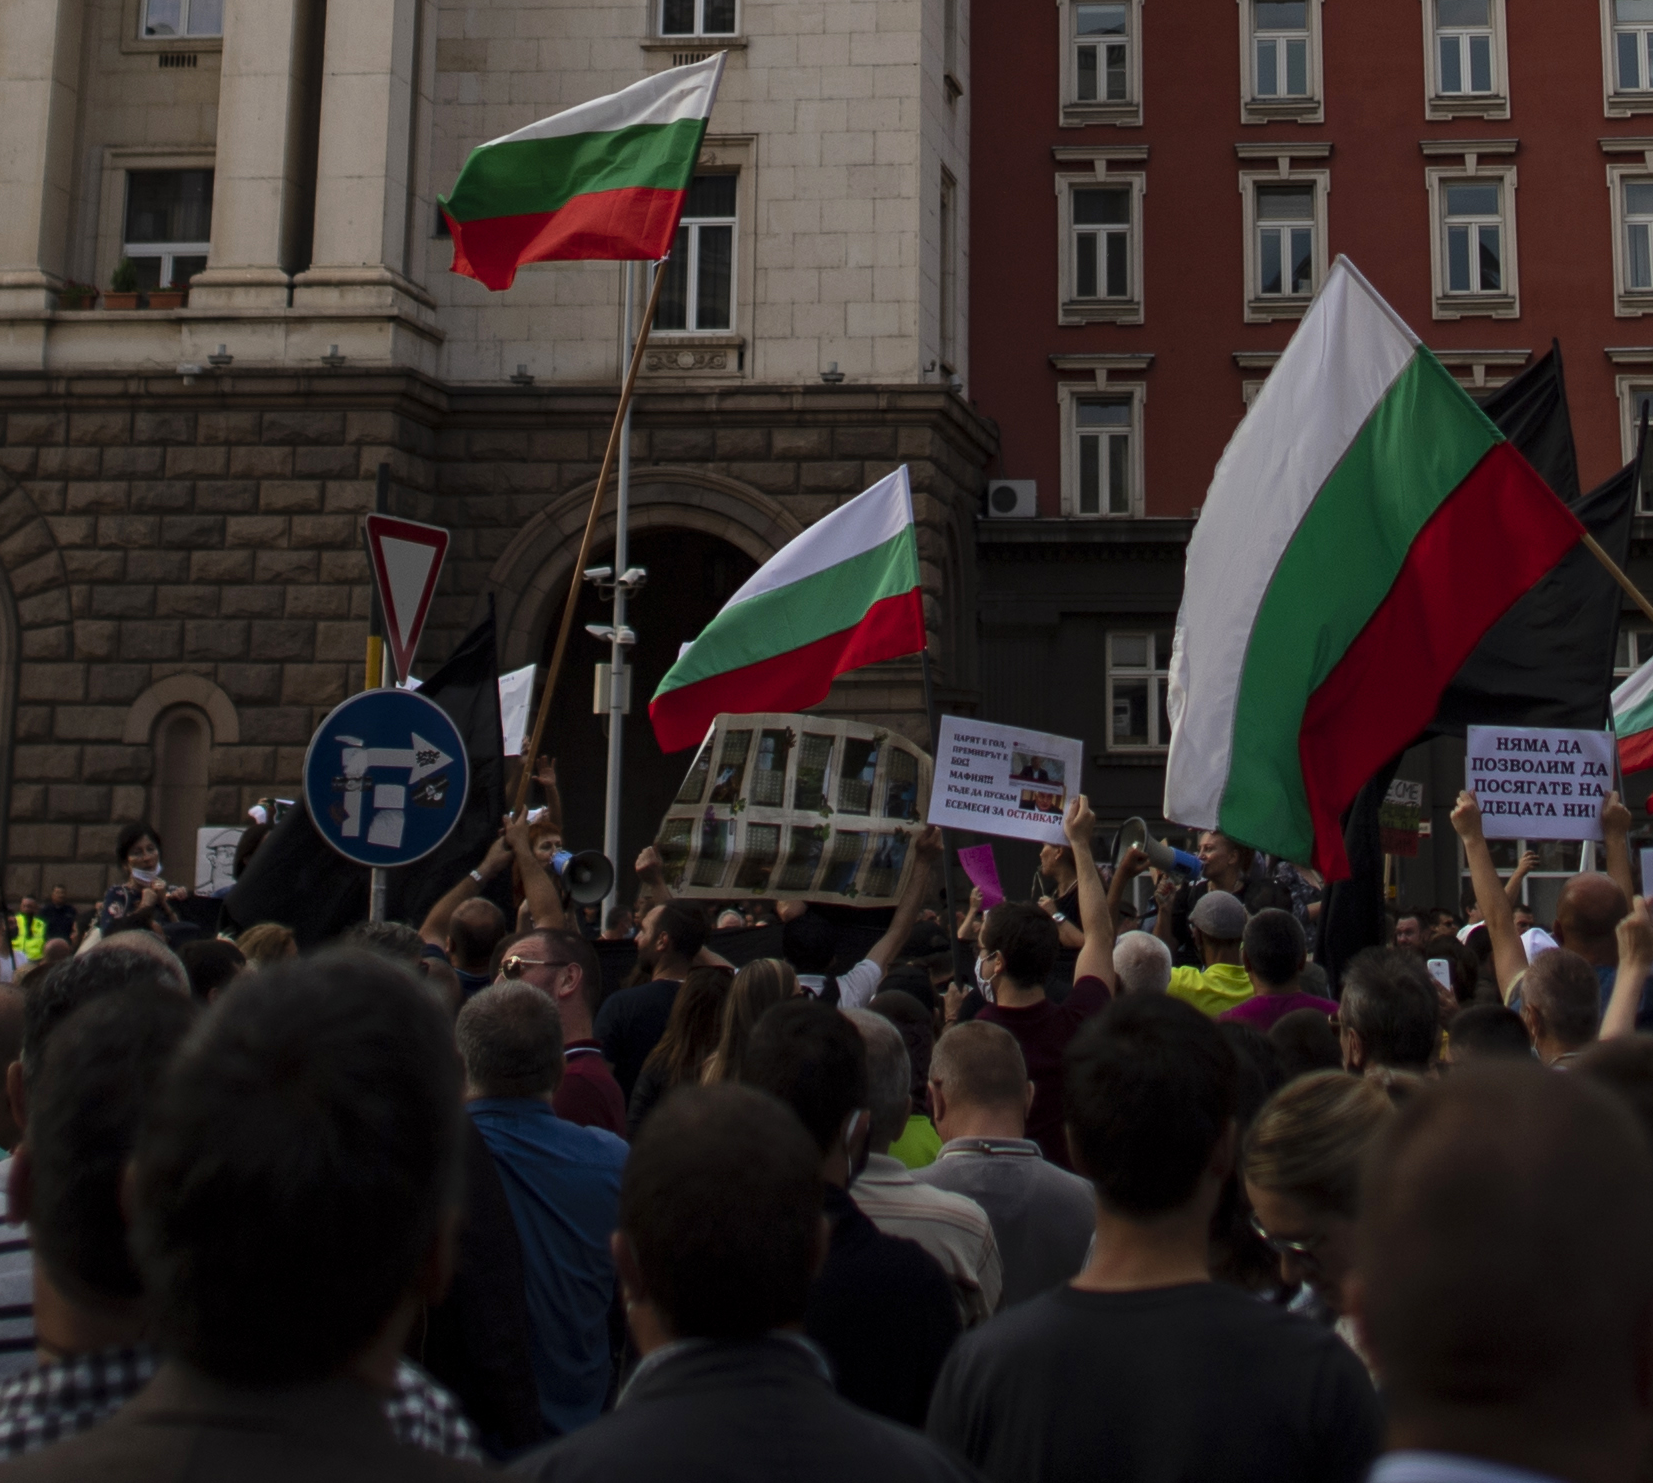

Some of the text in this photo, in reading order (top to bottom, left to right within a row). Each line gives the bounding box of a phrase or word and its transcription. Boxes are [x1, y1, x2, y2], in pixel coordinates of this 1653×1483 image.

[954, 733, 981, 745] ЦАРЯТ
[988, 738, 1007, 749] ГОЛ,
[1496, 737, 1582, 755] НЯМА ДА
[952, 745, 1001, 760] ПРЕМИЕРЪТ
[1471, 757, 1608, 777] ПОЗВОЛИМ ДА
[948, 784, 1017, 802] КЪДЕ ДА ПУСКАМ
[1474, 778, 1605, 797] ПОСЯГАТЕ НА
[945, 799, 990, 814] ЕСЕМЕСИ
[992, 806, 1004, 816] ЗА
[1481, 800, 1596, 818] ДЕЦАТА НИ!
